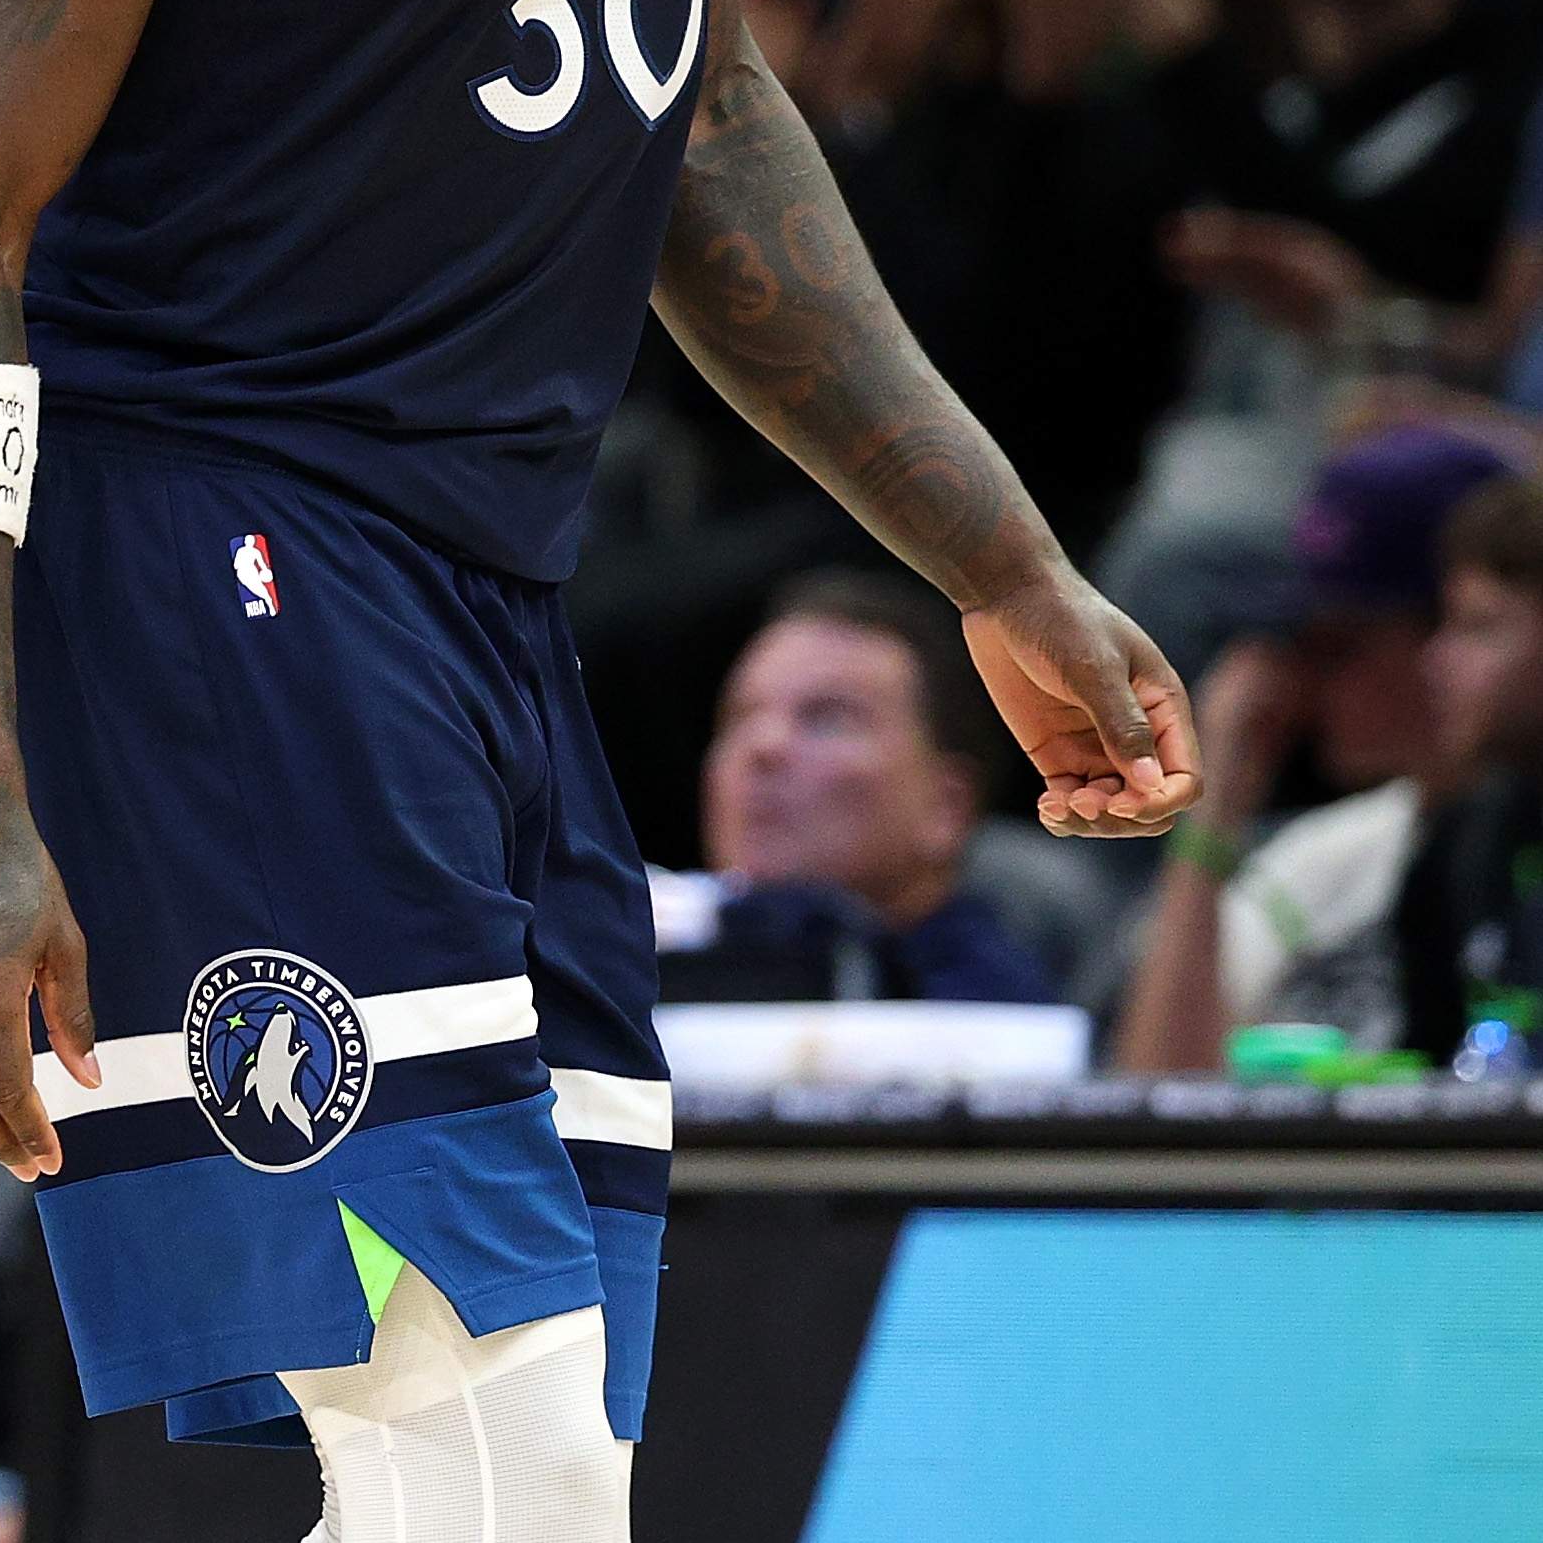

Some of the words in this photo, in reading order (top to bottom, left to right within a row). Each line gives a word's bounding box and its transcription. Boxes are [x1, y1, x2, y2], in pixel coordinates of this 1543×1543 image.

[244, 599, 267, 618] NBA
[189, 967, 240, 1101] MINNESOTA
[251, 961, 364, 1124] TIMBERWOLVES
